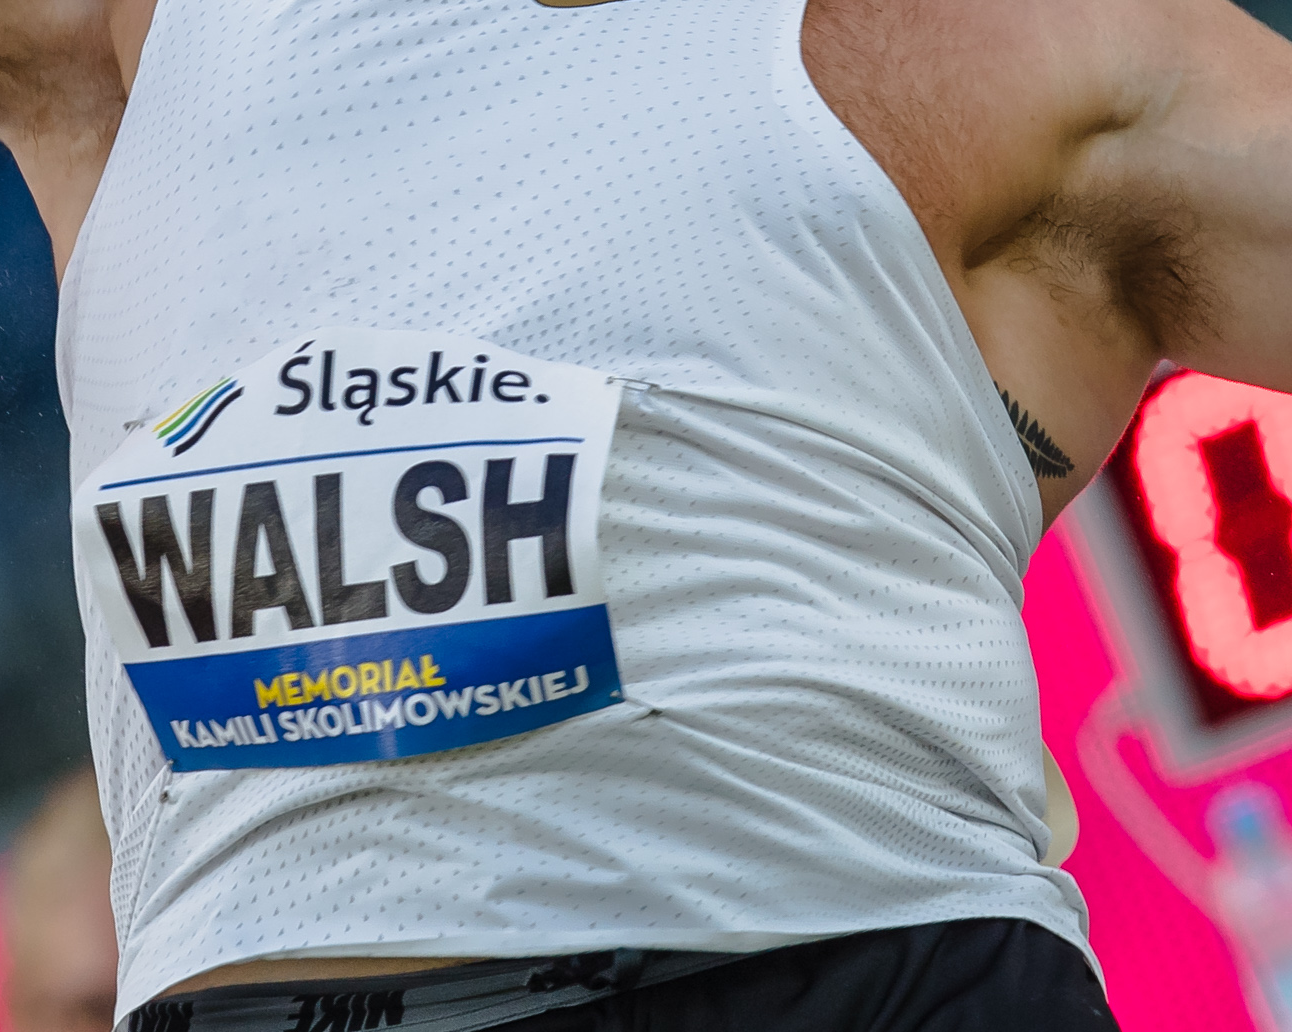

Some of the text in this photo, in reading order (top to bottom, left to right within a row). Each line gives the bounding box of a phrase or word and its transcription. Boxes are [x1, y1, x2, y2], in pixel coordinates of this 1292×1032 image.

[274, 340, 551, 426] Śląskie.
[94, 453, 579, 649] WALSH
[170, 665, 590, 751] KAMILI SKOLIMOWSKIEJ
[253, 654, 447, 710] MEMORIAŁ
